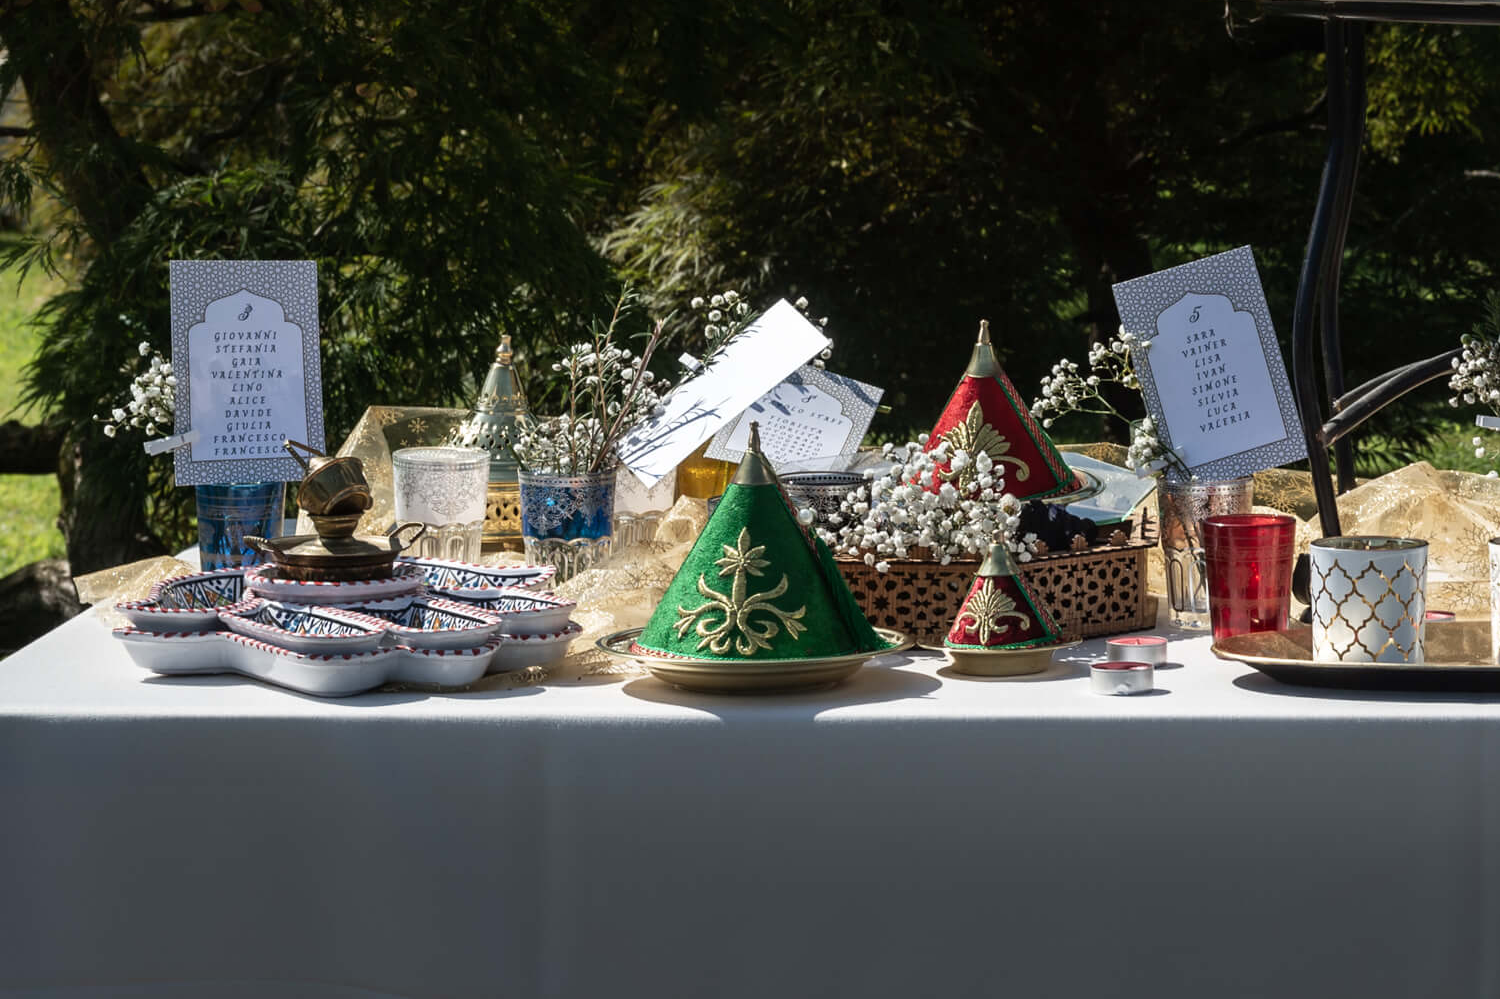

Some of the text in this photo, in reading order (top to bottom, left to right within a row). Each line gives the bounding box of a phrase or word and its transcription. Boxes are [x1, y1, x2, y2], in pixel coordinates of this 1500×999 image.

[238, 304, 253, 321] 3
[1189, 306, 1202, 322] 5
[214, 330, 278, 342] GIOVANNI
[1187, 329, 1216, 344] SARA
[216, 344, 277, 354] STEFANIA
[1182, 339, 1227, 358] VAINER
[232, 357, 261, 368] GAIA
[1195, 354, 1221, 368] LISA
[212, 369, 283, 378] VALENTINA
[1197, 363, 1226, 380] IVAN
[232, 383, 262, 392] LINO
[1192, 374, 1237, 396] SIMONE
[230, 396, 266, 405] ALICE
[1198, 388, 1239, 407] SILVIA
[225, 408, 272, 418] DAVIDE
[1208, 402, 1236, 418] LUCA
[227, 422, 271, 432] GIULIA
[1200, 411, 1250, 432] VALERIA
[214, 434, 286, 444] FRANCESCO
